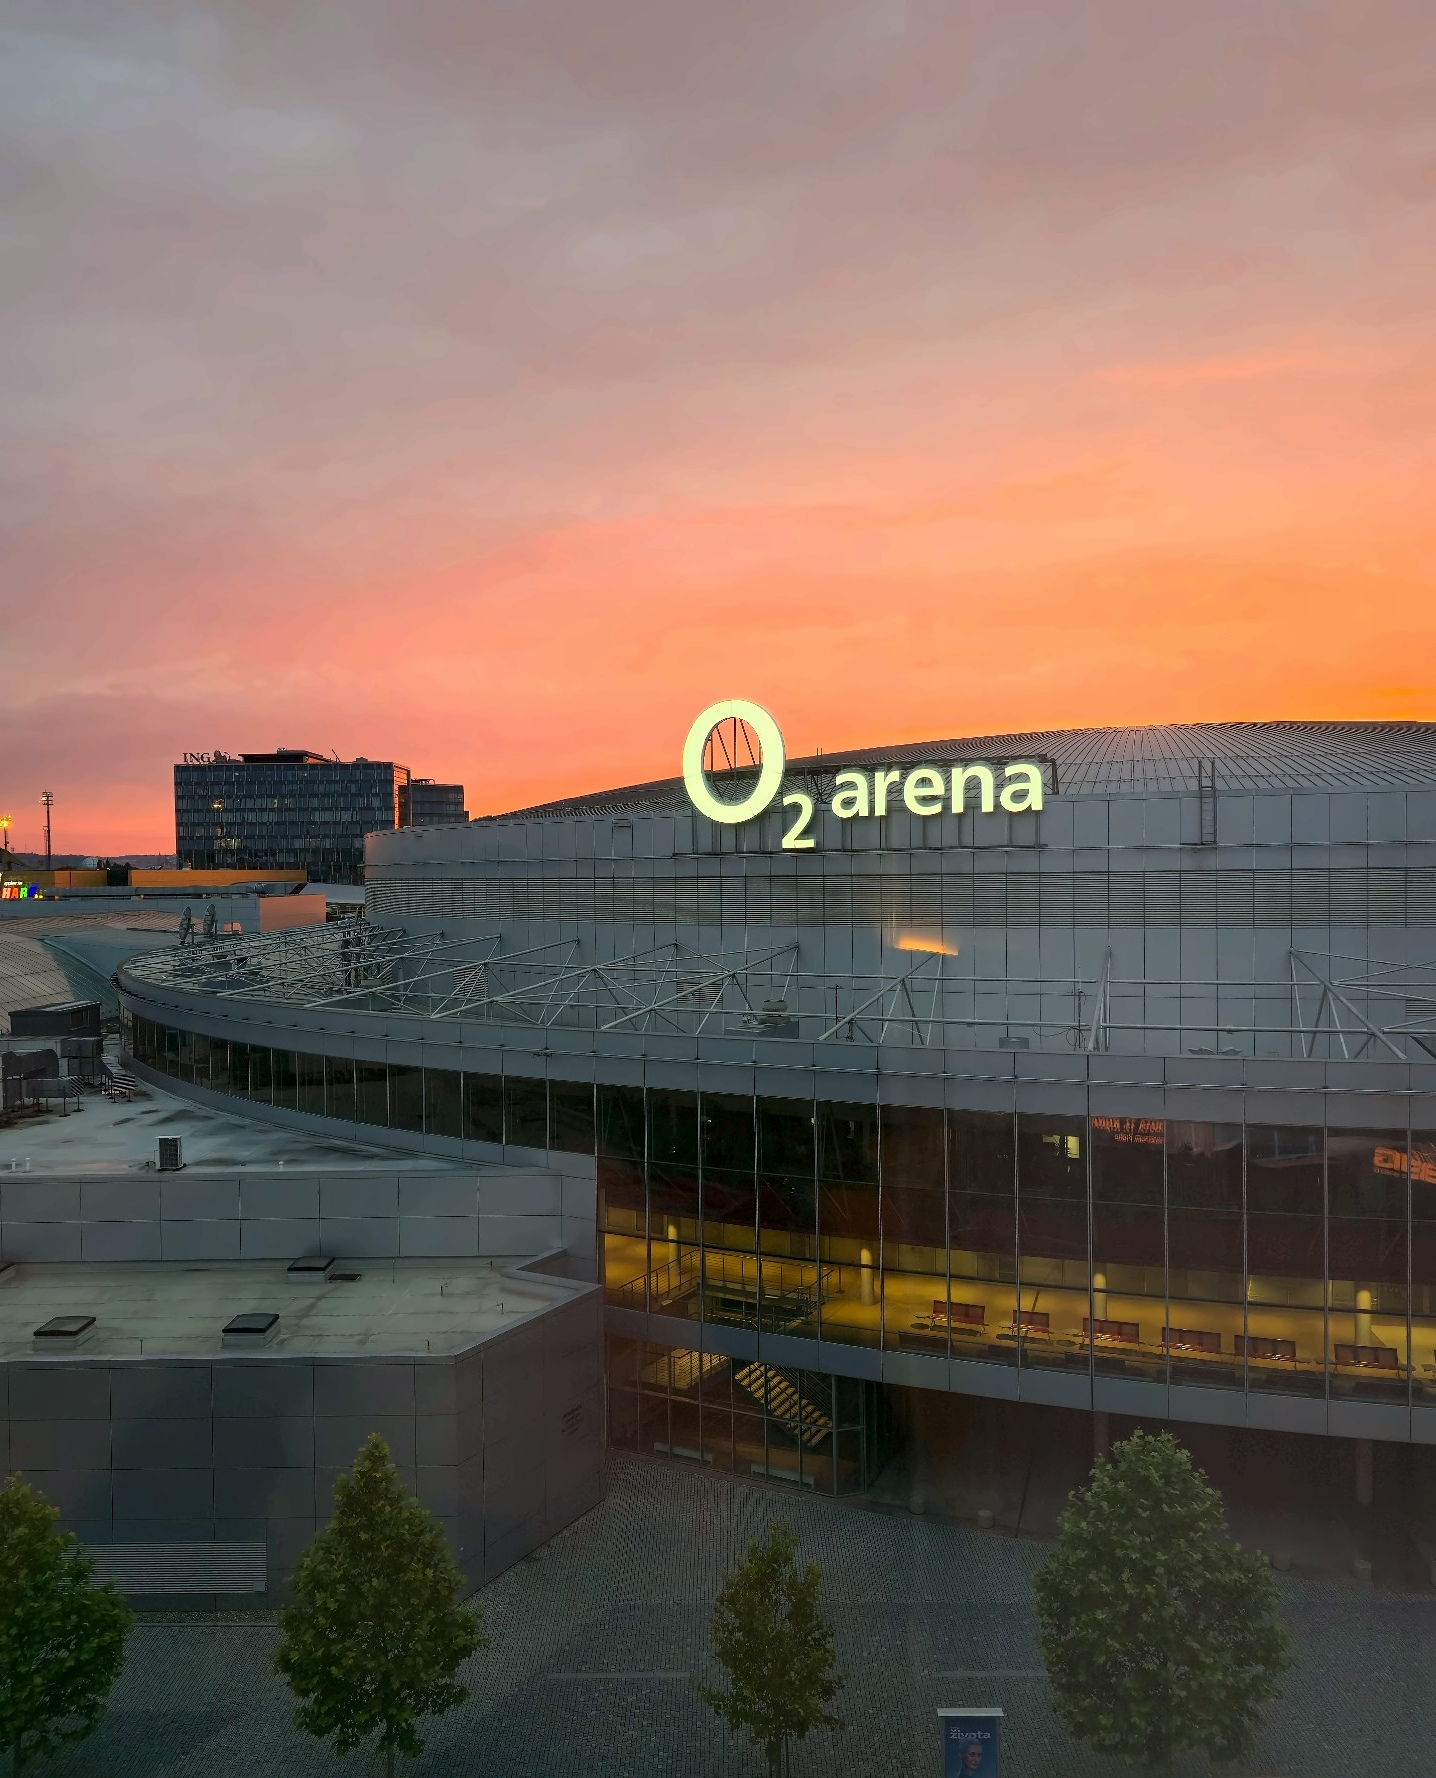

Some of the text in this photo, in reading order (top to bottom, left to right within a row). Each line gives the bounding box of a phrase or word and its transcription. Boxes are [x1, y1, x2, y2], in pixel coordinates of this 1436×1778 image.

[183, 752, 211, 763] ING
[682, 699, 1044, 849] O2 arena
[950, 1728, 991, 1739] života
